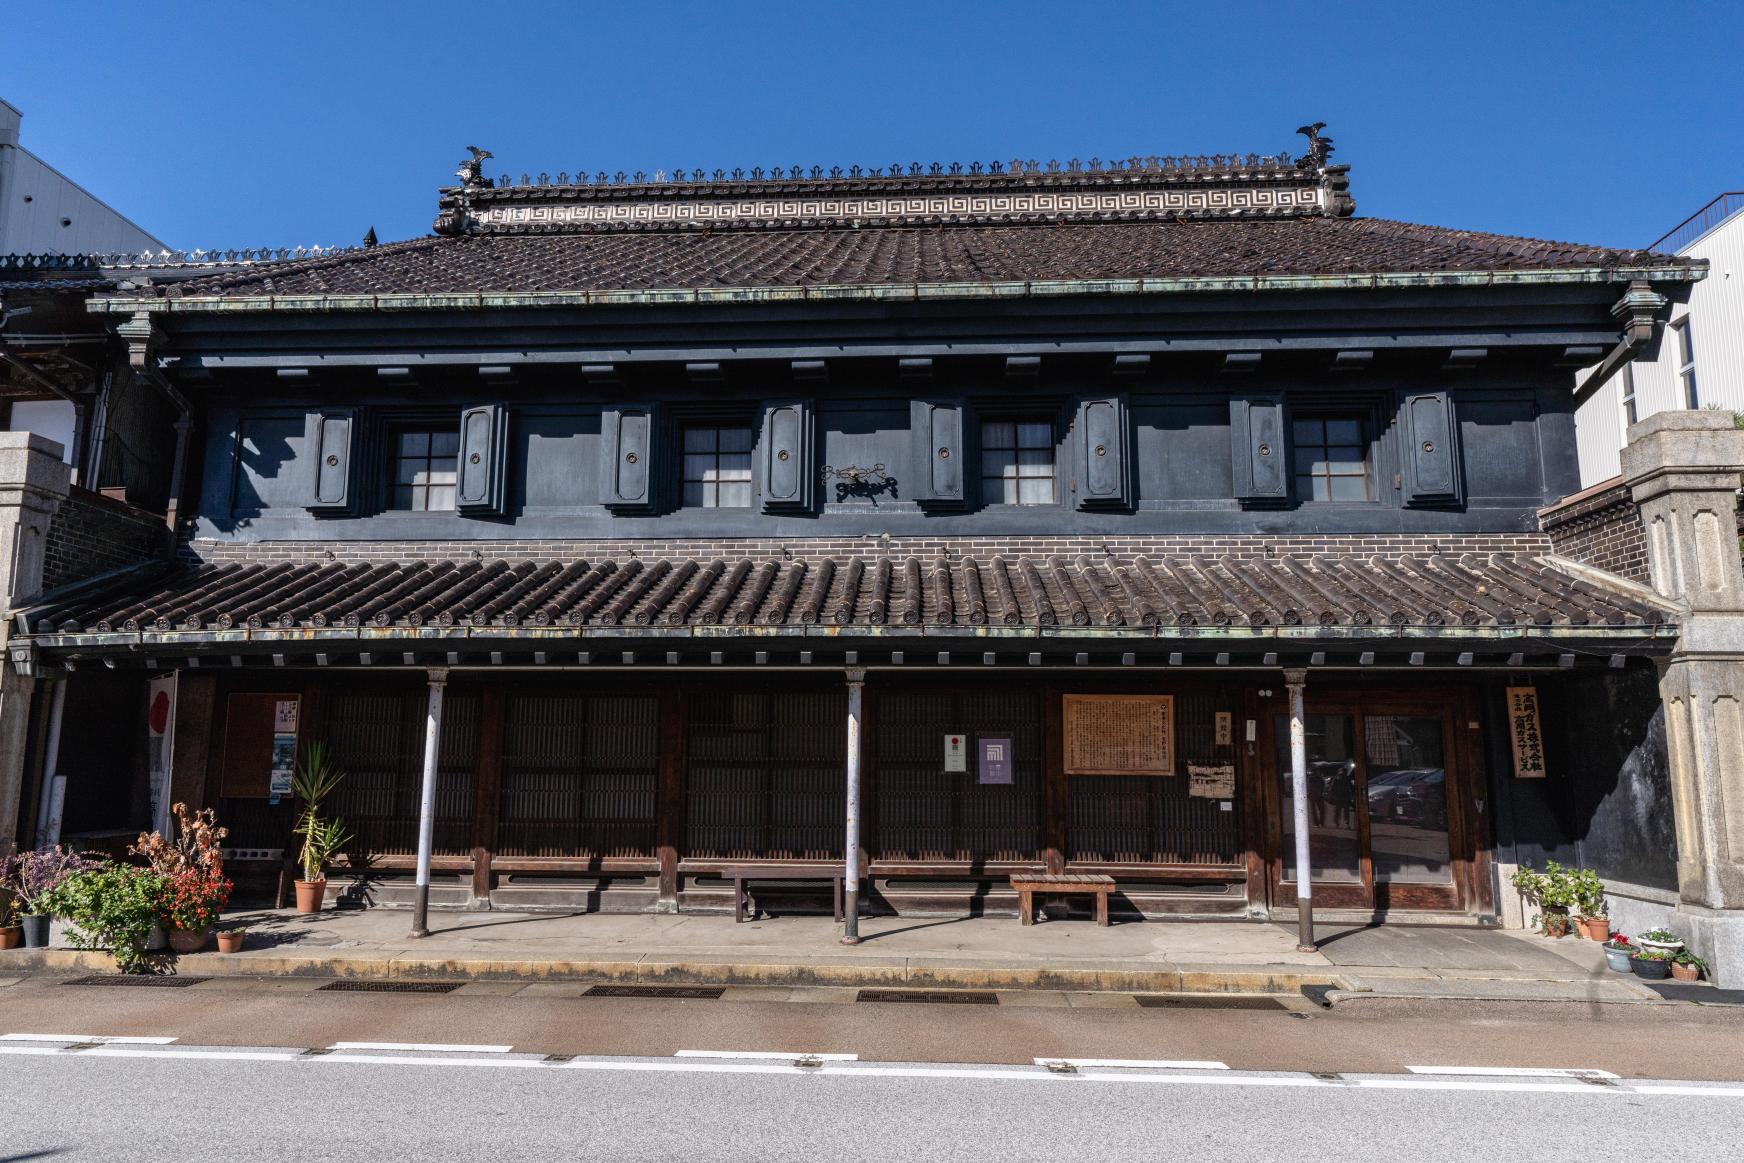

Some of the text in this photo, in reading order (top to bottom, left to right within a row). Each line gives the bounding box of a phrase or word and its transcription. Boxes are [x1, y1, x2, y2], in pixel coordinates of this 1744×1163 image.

[1514, 715, 1529, 771] 高岡ガスサービス
[1523, 693, 1542, 771] 高岡ガス株式会社
